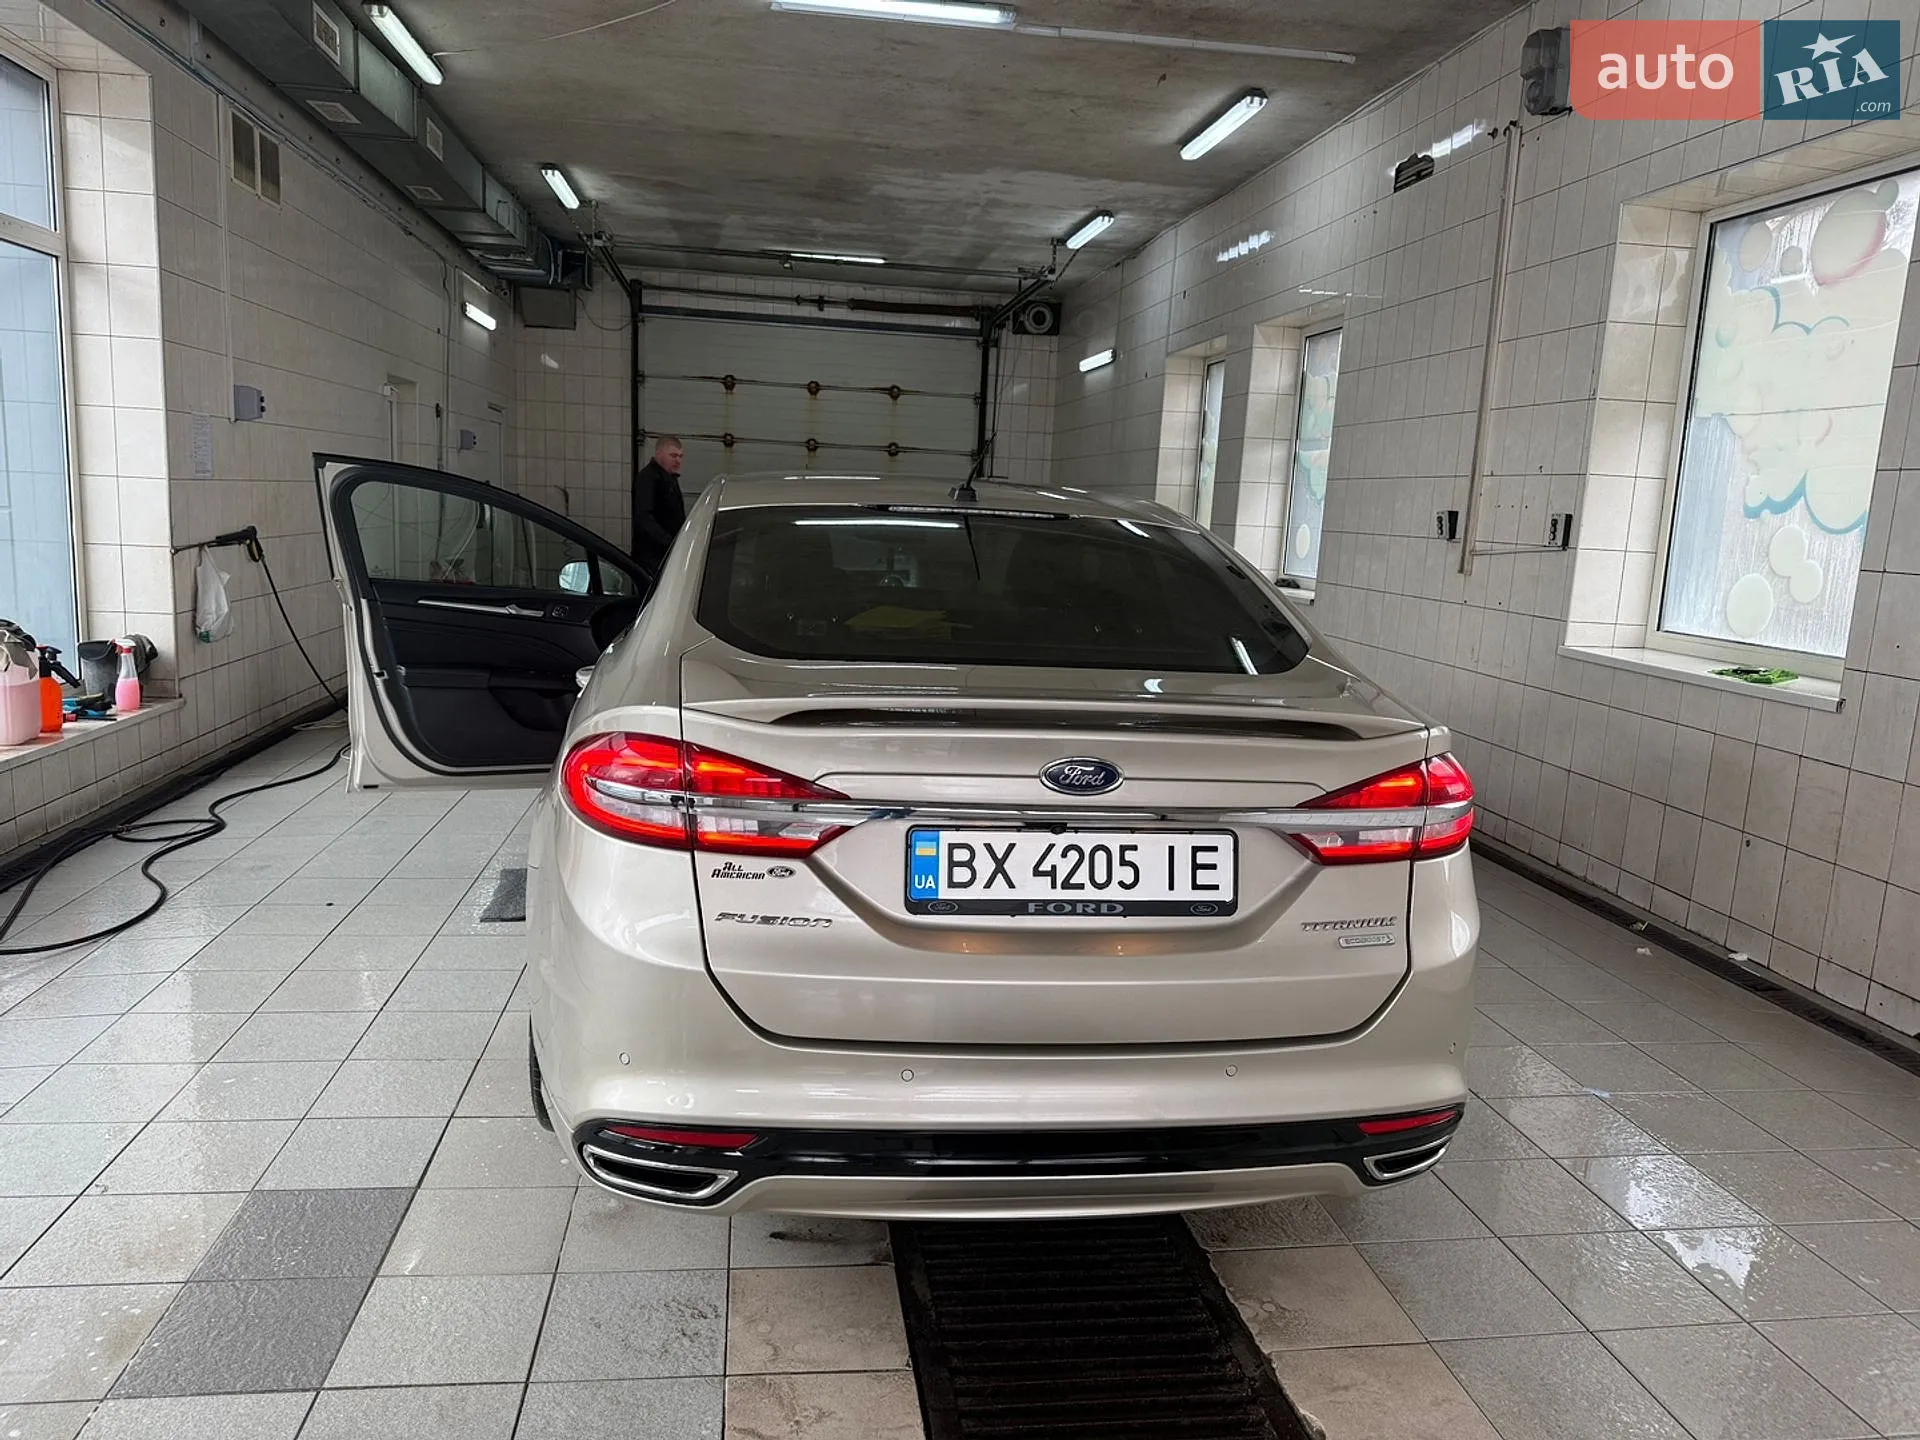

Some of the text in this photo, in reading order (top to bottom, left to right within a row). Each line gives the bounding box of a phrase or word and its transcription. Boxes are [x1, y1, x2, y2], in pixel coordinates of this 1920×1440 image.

[1059, 765, 1106, 786] Ford
[947, 842, 1220, 891] BX 4205 IE
[914, 875, 936, 889] UA
[1027, 902, 1125, 915] FORD
[714, 912, 833, 928] FUSION
